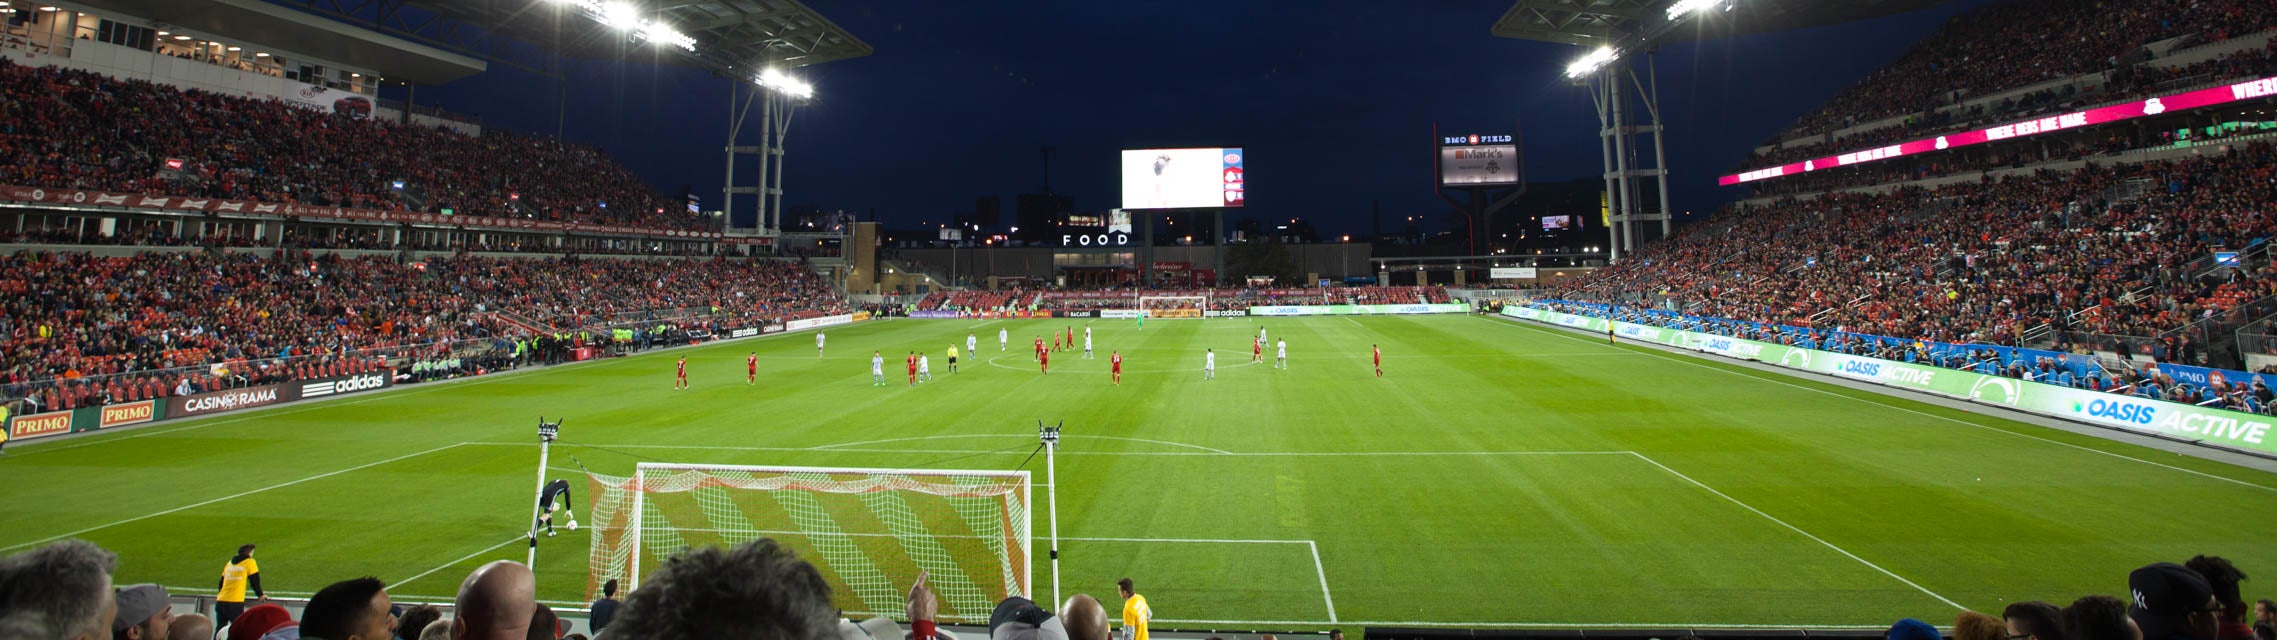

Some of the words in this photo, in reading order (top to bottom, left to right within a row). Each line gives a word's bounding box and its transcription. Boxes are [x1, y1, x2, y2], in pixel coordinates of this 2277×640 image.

[1465, 148, 1504, 159] Mark's
[1063, 234, 1128, 246] FOOD
[742, 325, 758, 336] adidas
[1709, 338, 1731, 350] OASIS
[1846, 360, 1880, 376] OASIS
[1883, 366, 1934, 386] ACTIVE
[2180, 372, 2205, 383] BMO
[336, 374, 384, 393] adidas
[185, 394, 238, 412] CASINO
[238, 389, 277, 404] RAMA
[106, 406, 150, 422] PRIMO
[2088, 399, 2154, 424] OASIS
[2158, 410, 2270, 444] ACTIVE
[16, 416, 68, 435] PRIMO
